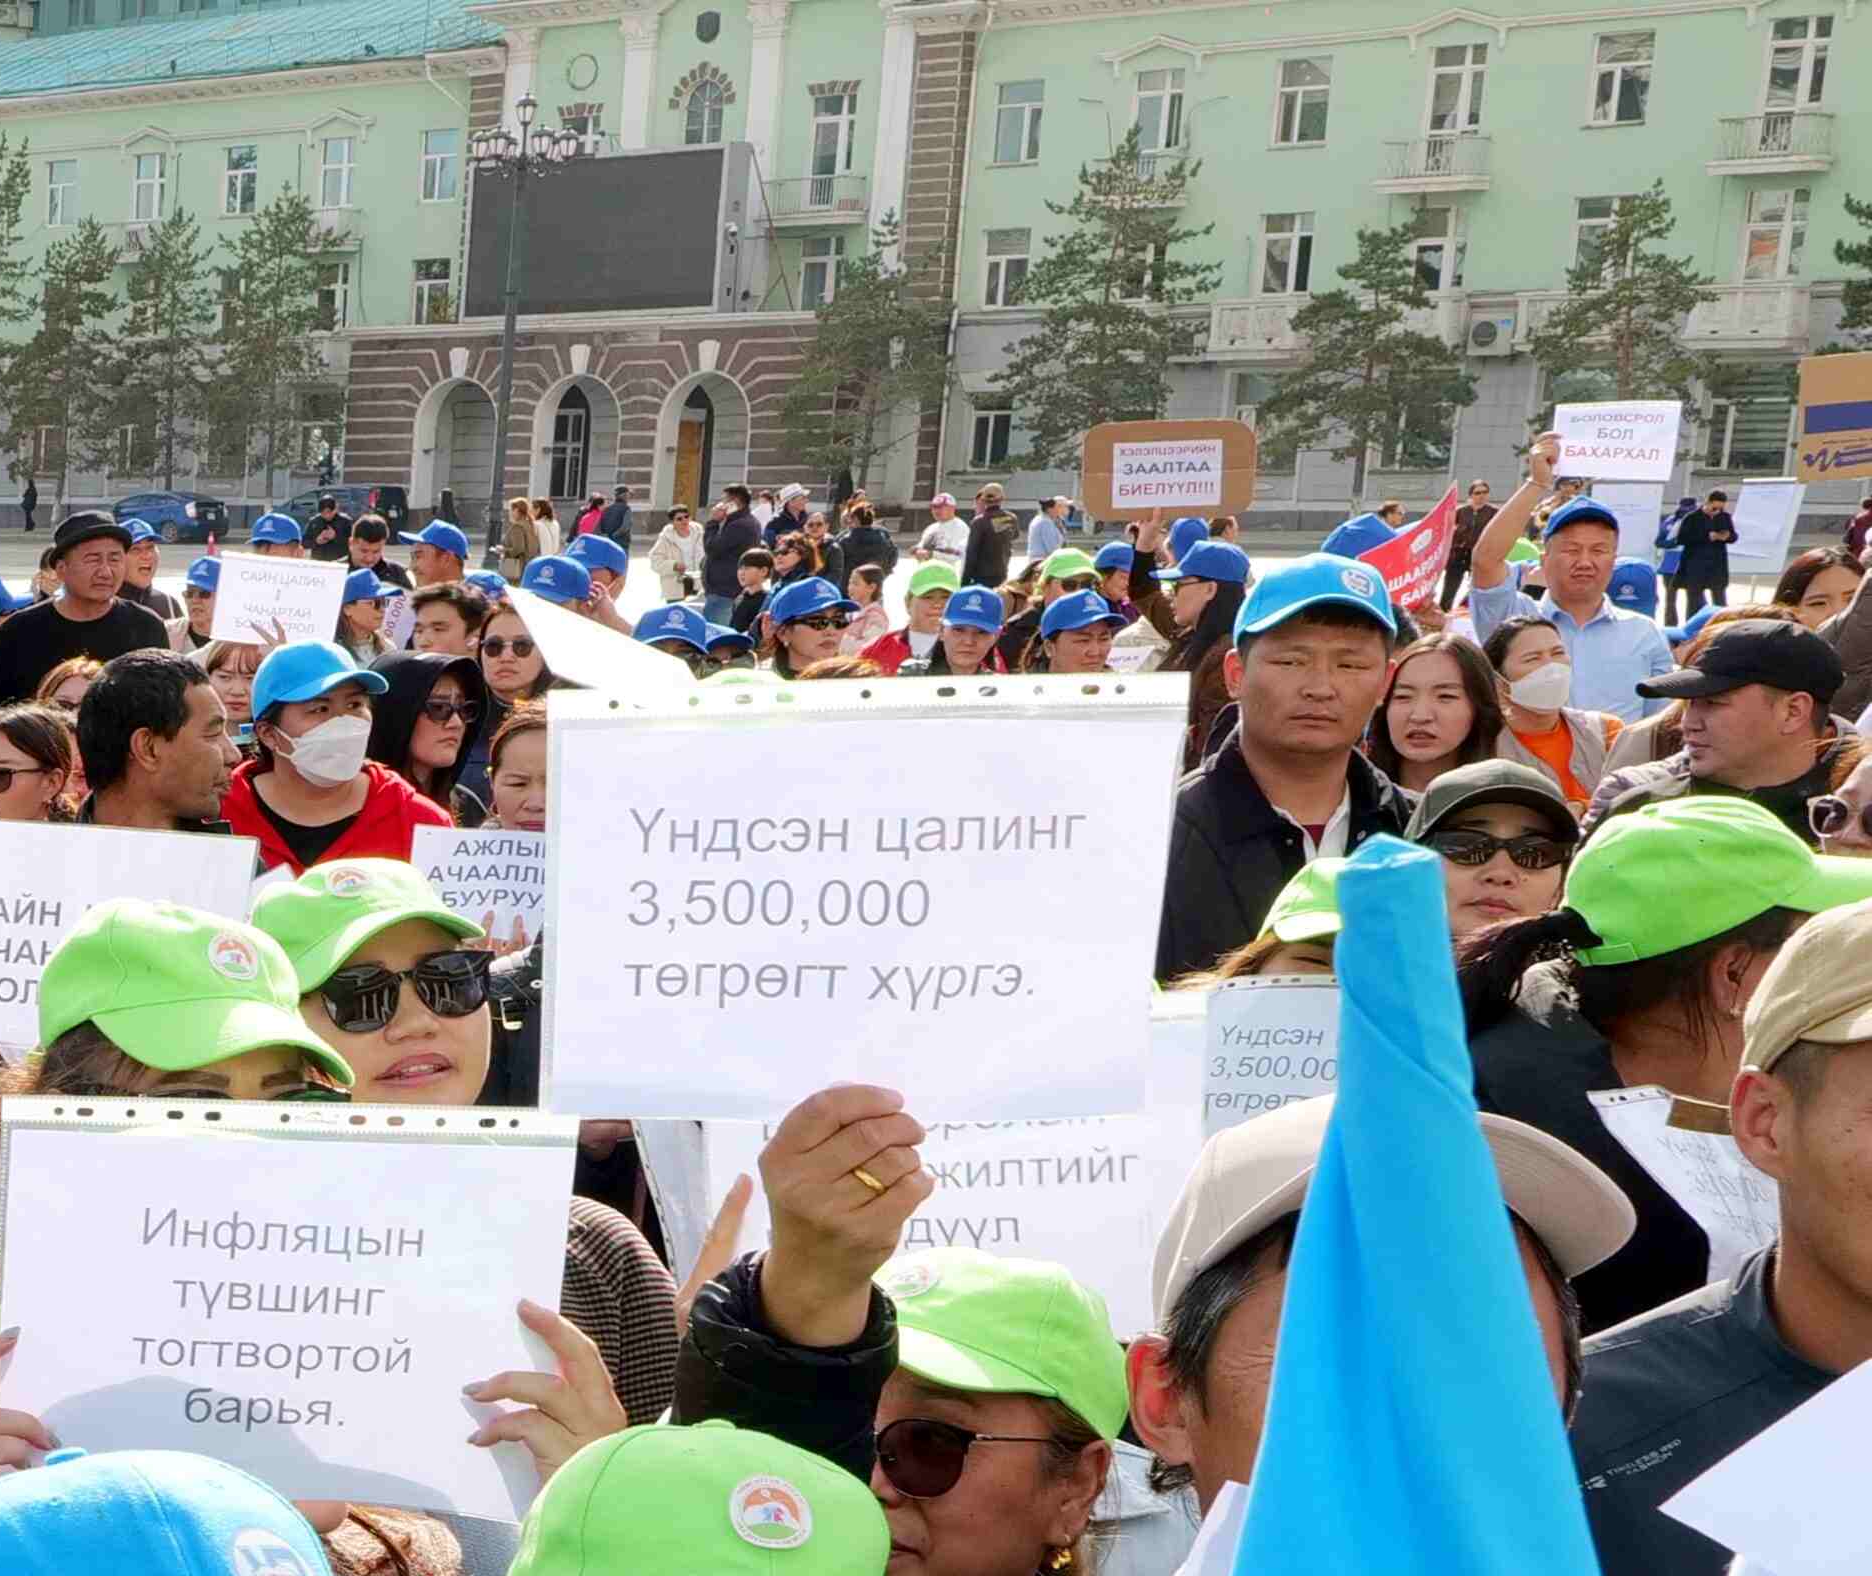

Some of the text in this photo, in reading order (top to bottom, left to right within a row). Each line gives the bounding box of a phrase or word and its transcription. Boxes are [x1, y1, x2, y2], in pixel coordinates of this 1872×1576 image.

[1597, 427, 1634, 441] БОЛ
[1564, 445, 1661, 460] БАХАРХАЛ
[1122, 460, 1212, 476] ЗААЛТАА
[1119, 480, 1215, 497] БИЕЛҮҮЛ!!!
[628, 807, 1087, 861] Үндсэн цалинг
[426, 864, 546, 885] АЧААЛЛ
[441, 889, 545, 910] БУУРУУ
[627, 878, 932, 934] 3,500,000
[624, 960, 1036, 1010] төгрөгт хүргэ.
[1220, 1024, 1325, 1048] Үндсэн
[1209, 1055, 1339, 1082] 3,500,00
[140, 1206, 425, 1260] Инфляцын
[172, 1275, 386, 1320] түвшинг
[132, 1333, 412, 1376] тогтвортой
[183, 1390, 347, 1437] барья.
